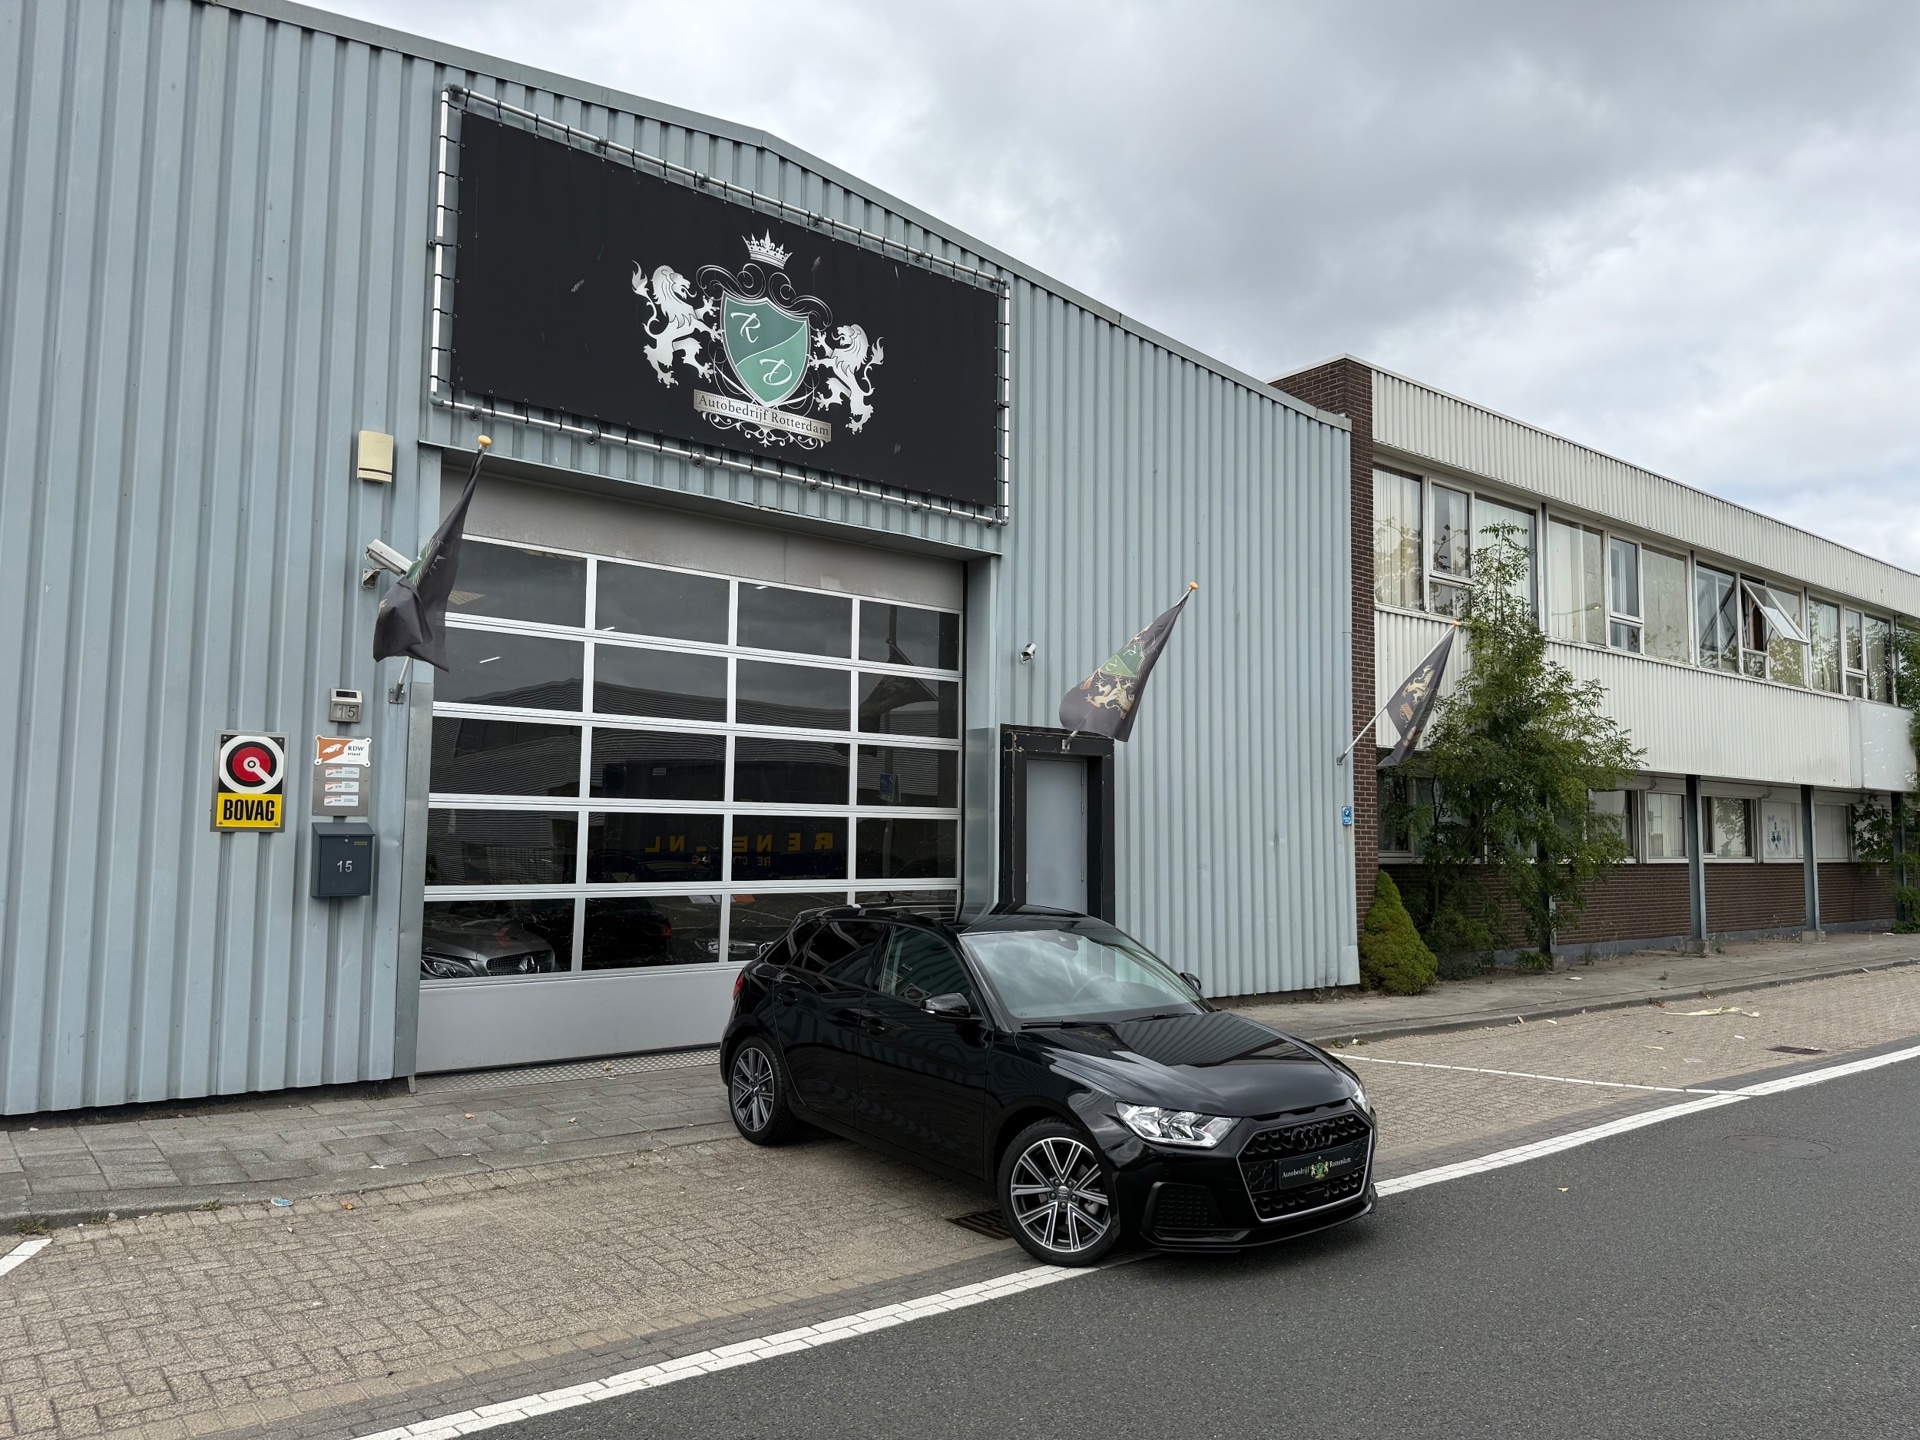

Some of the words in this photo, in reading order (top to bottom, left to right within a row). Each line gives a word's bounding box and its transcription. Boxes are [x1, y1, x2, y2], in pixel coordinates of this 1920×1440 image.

[730, 311, 761, 344] R
[698, 395, 771, 422] Autobedrijf
[771, 408, 830, 436] Rotterdam
[337, 706, 356, 719] 15
[223, 798, 275, 822] BOVAG
[336, 860, 353, 873] 15
[1282, 1165, 1311, 1178] Autobedrijf
[1329, 1156, 1352, 1168] Rotterdam
